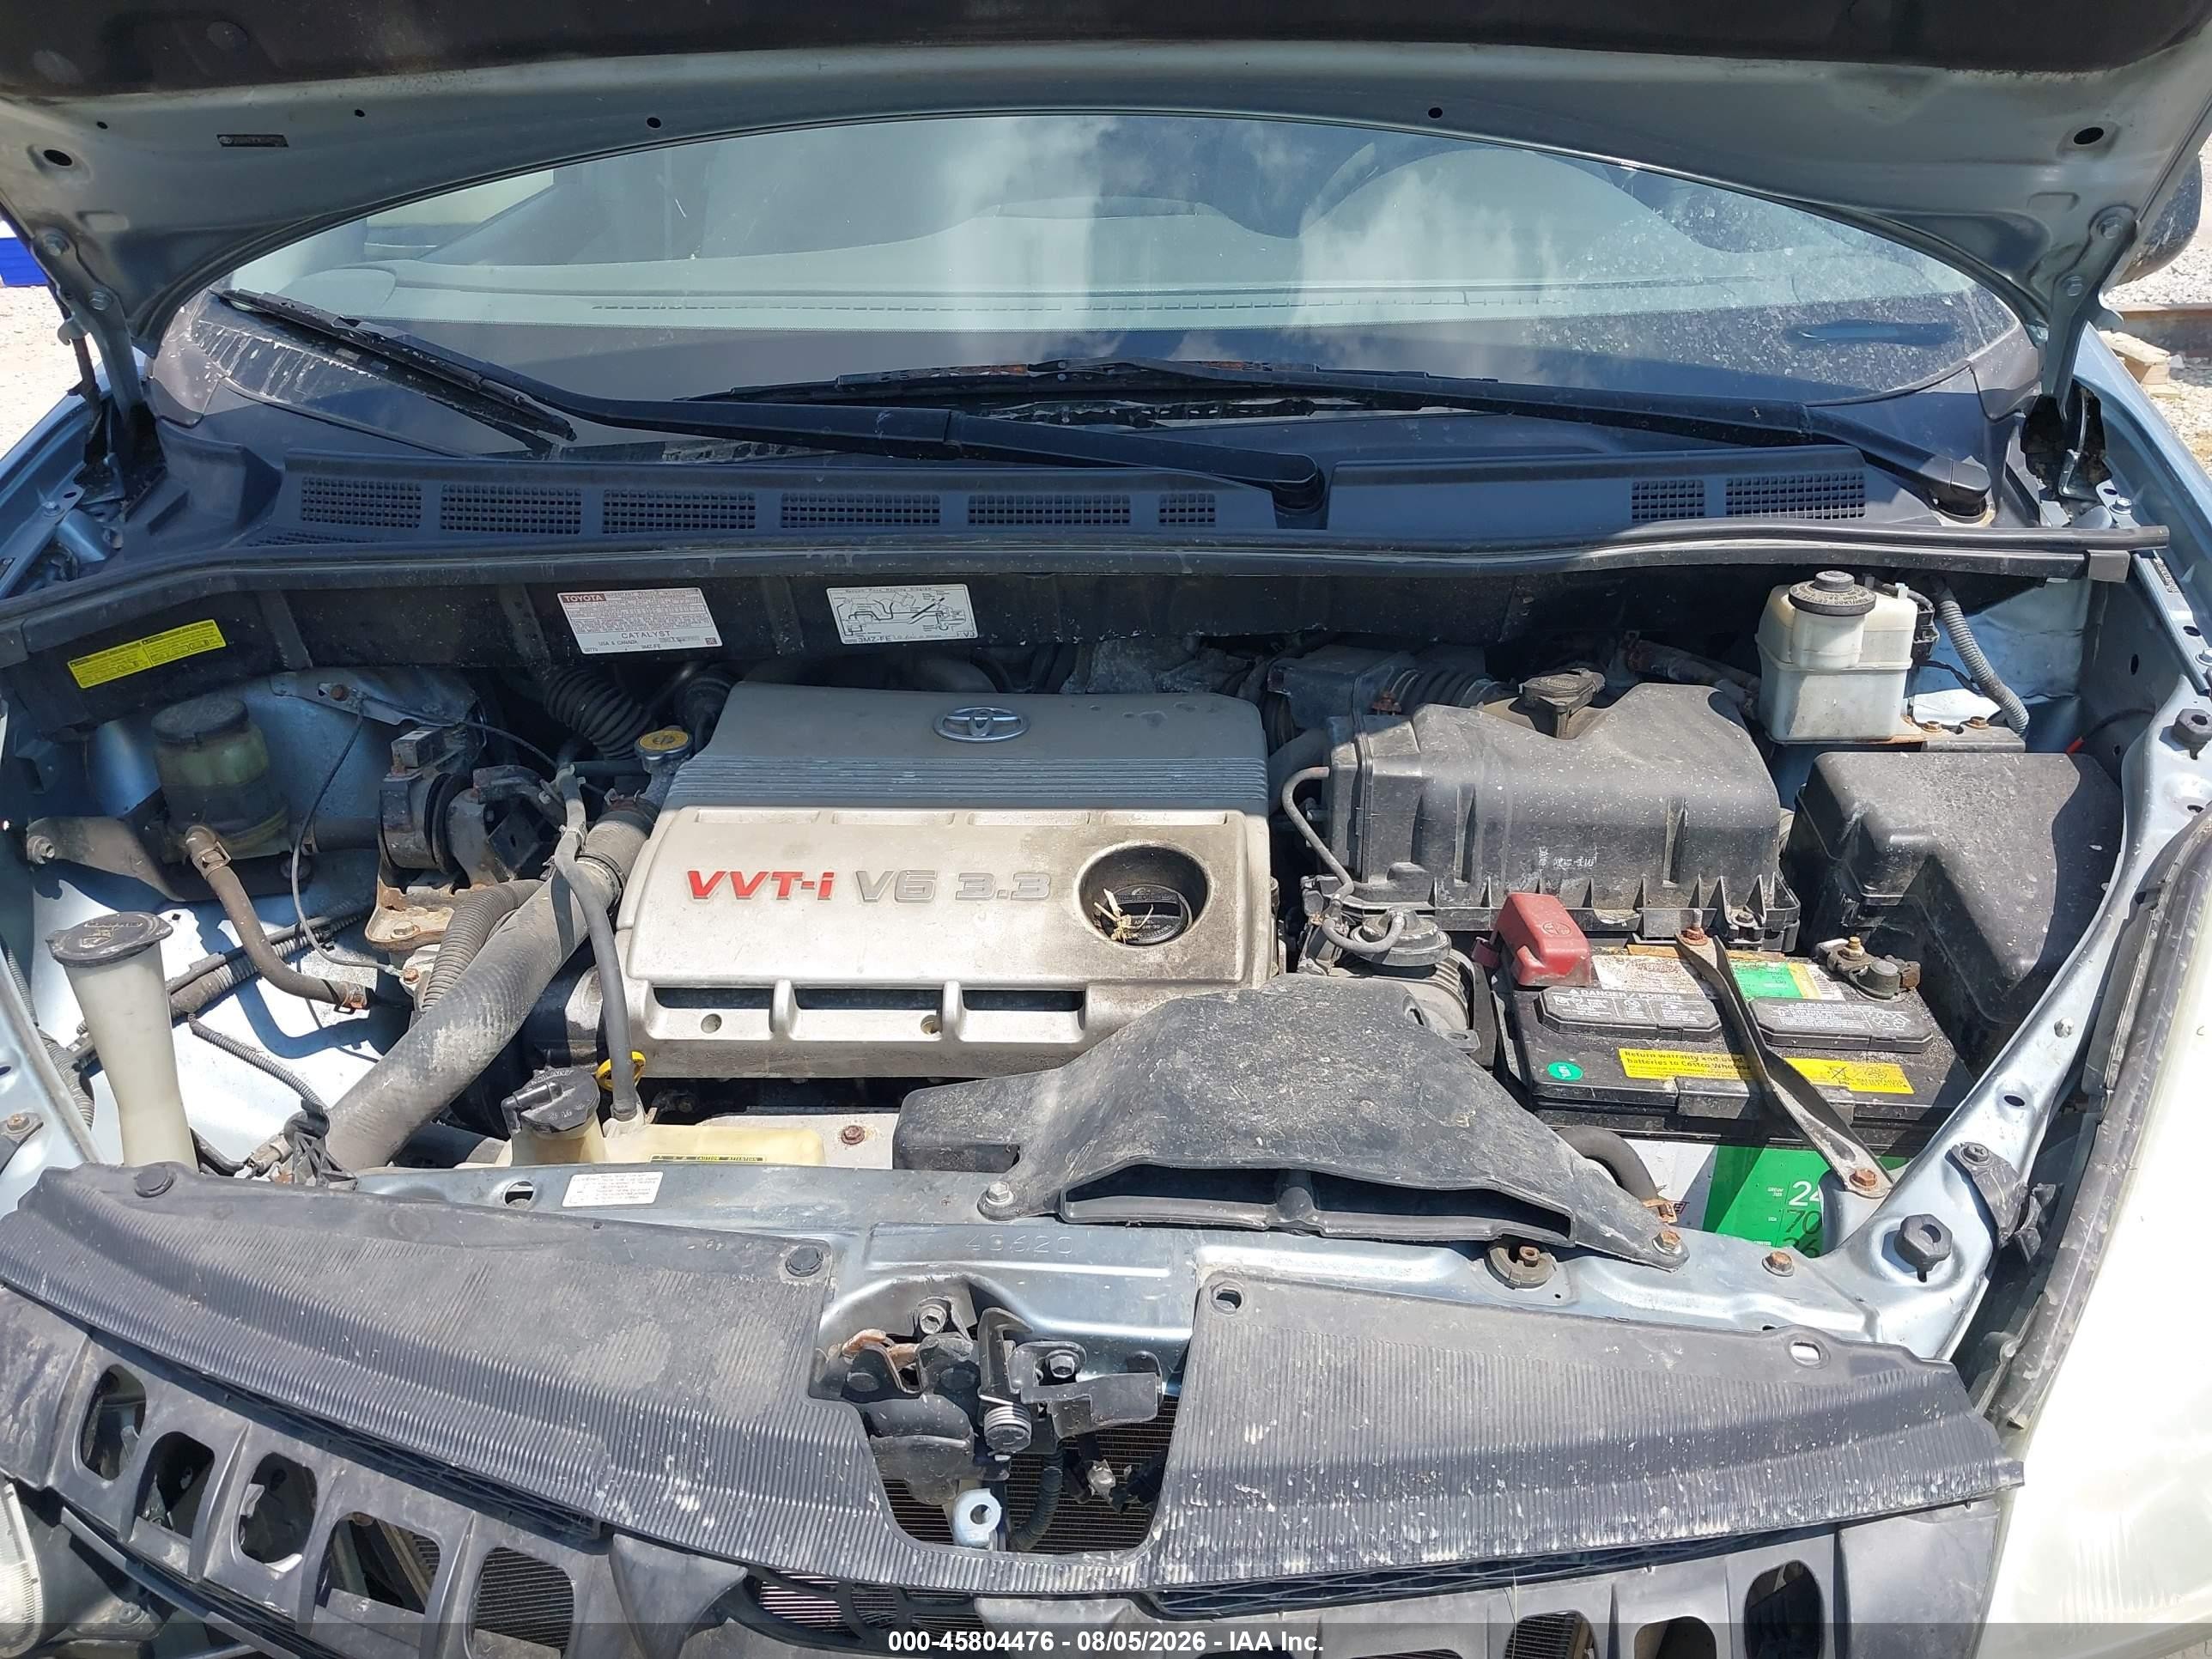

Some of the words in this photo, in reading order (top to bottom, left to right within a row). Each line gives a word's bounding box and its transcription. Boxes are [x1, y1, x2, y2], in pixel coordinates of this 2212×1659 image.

[621, 630, 671, 639] CATALYST
[687, 870, 836, 901] VVT-i
[855, 869, 939, 903] V6
[955, 872, 1052, 902] 3.3
[1581, 989, 1627, 998] DANGER
[1627, 1057, 1668, 1066] batteries
[1658, 1053, 1698, 1062] warranty
